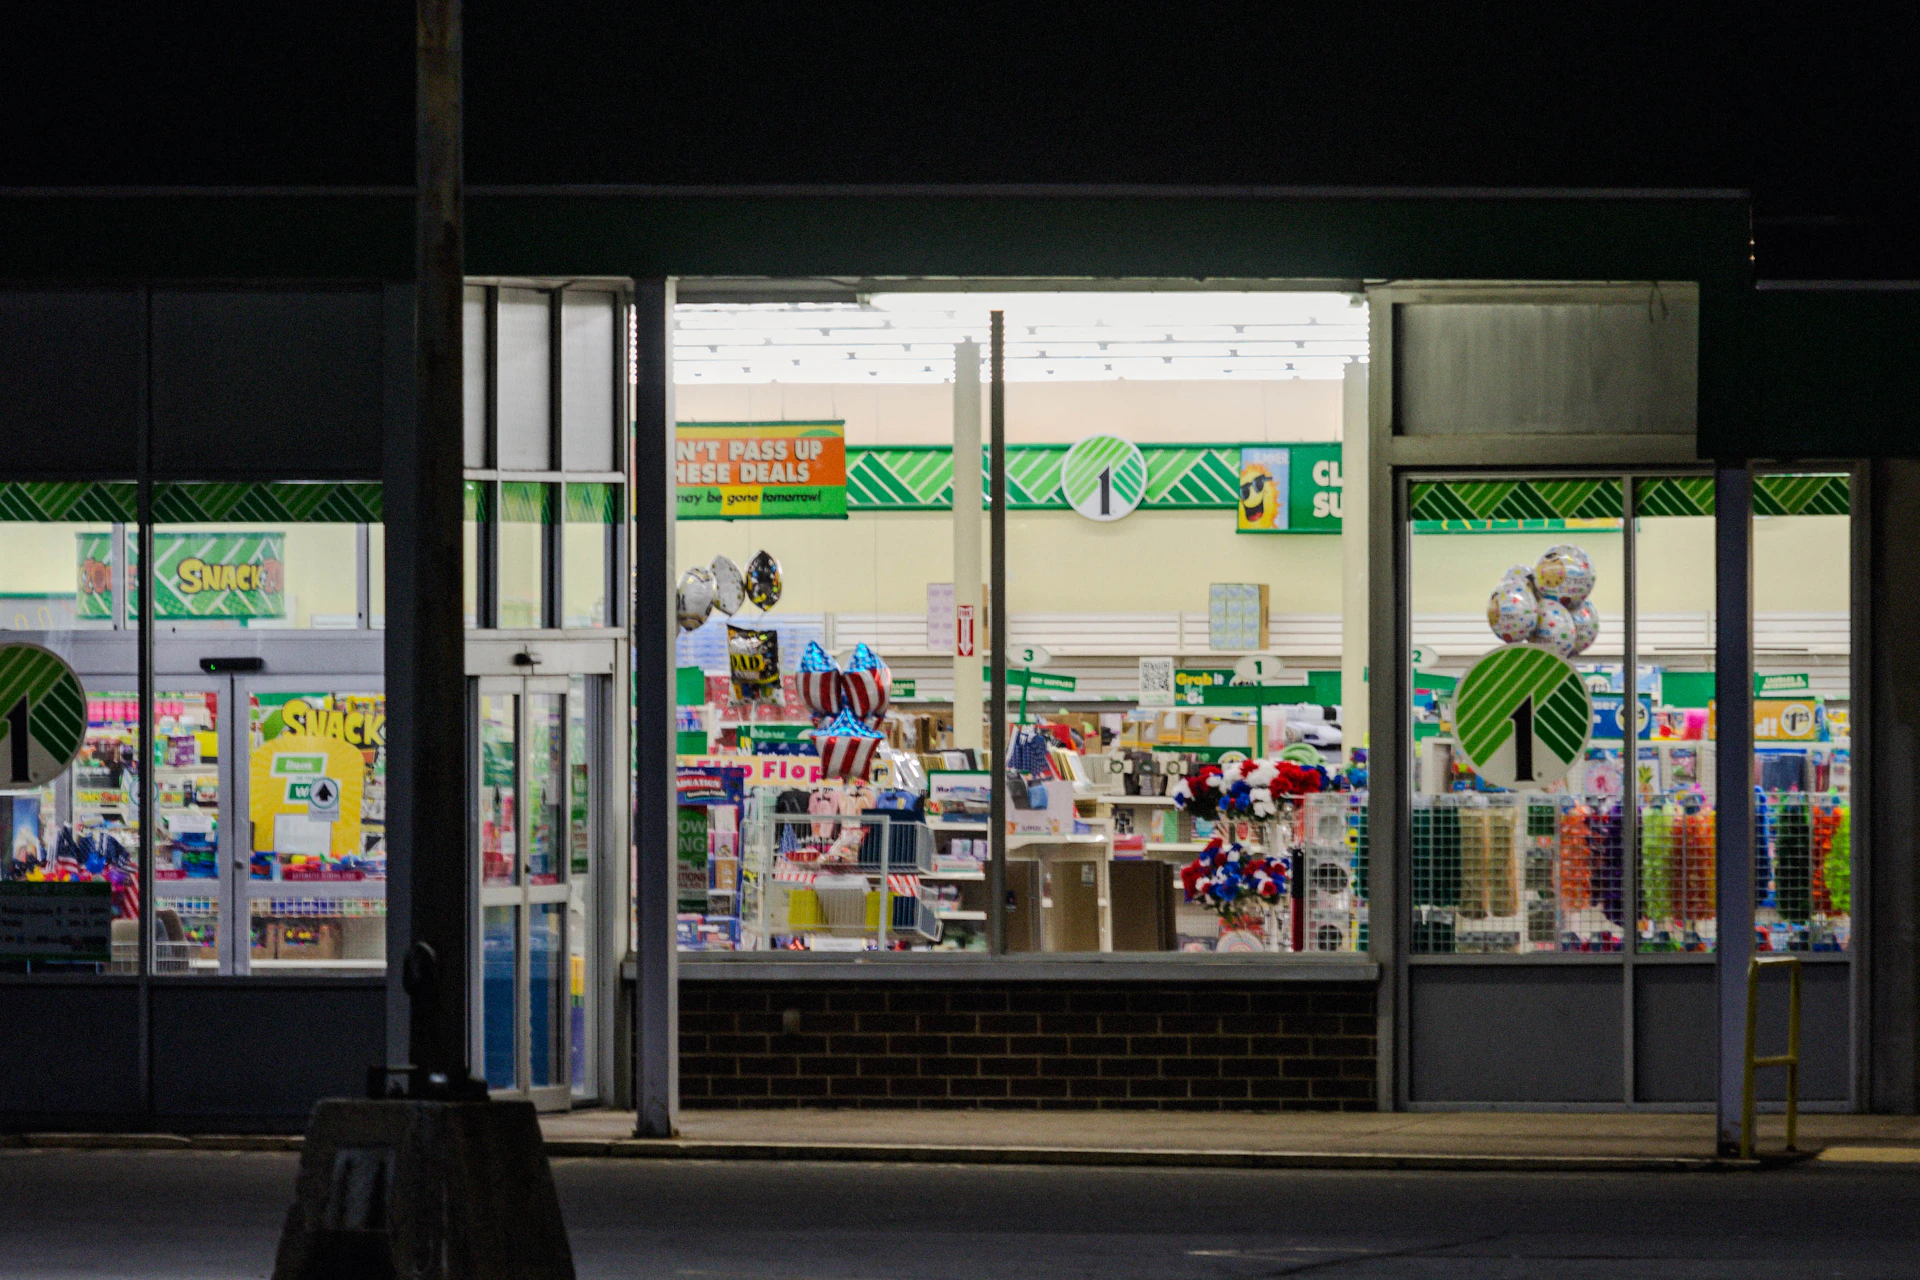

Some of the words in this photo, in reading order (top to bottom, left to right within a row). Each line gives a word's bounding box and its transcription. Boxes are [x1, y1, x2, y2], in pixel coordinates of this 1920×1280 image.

[729, 440, 788, 461] PASS
[795, 439, 824, 461] UP
[740, 462, 810, 484] DEALS
[707, 491, 723, 504] be
[727, 494, 759, 507] gone
[763, 491, 821, 504] tomorrow!
[1099, 466, 1111, 516] 1
[178, 557, 264, 594] SNACK
[730, 654, 764, 671] DAD
[1023, 650, 1034, 662] 3
[1412, 650, 1422, 663] 2
[1254, 660, 1263, 675] 1
[1175, 673, 1213, 686] Grab
[281, 699, 386, 746] SNACK
[5, 692, 31, 783] 1
[1508, 694, 1536, 783] 1
[762, 760, 840, 783] Flop
